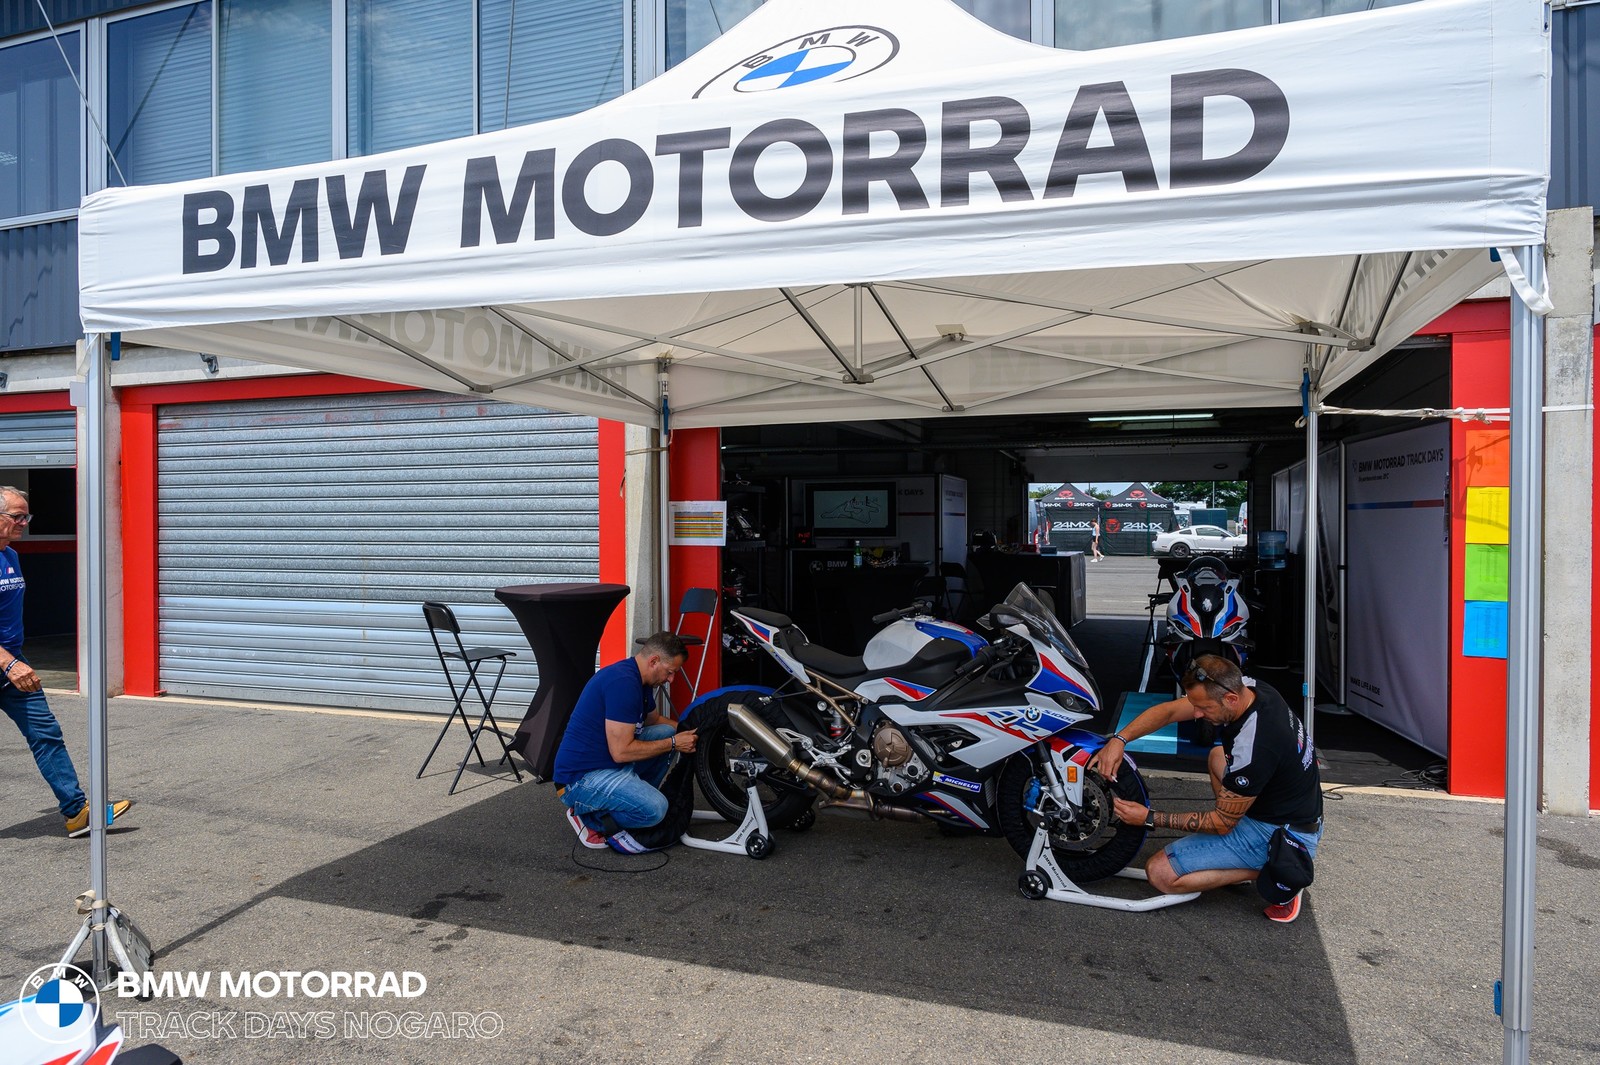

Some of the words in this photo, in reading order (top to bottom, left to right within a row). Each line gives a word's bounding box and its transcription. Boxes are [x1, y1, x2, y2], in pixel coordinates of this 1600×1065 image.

[742, 31, 880, 69] BMW
[182, 164, 427, 274] BMW
[460, 68, 1290, 248] MOTORRAD
[1358, 460, 1373, 472] BMW
[1373, 455, 1405, 470] MOTORRAD
[1406, 450, 1426, 466] TRACK
[1427, 447, 1444, 463] DAYS
[904, 488, 924, 496] DAYS
[827, 560, 848, 568] BMW
[944, 777, 980, 790] MICHELIN
